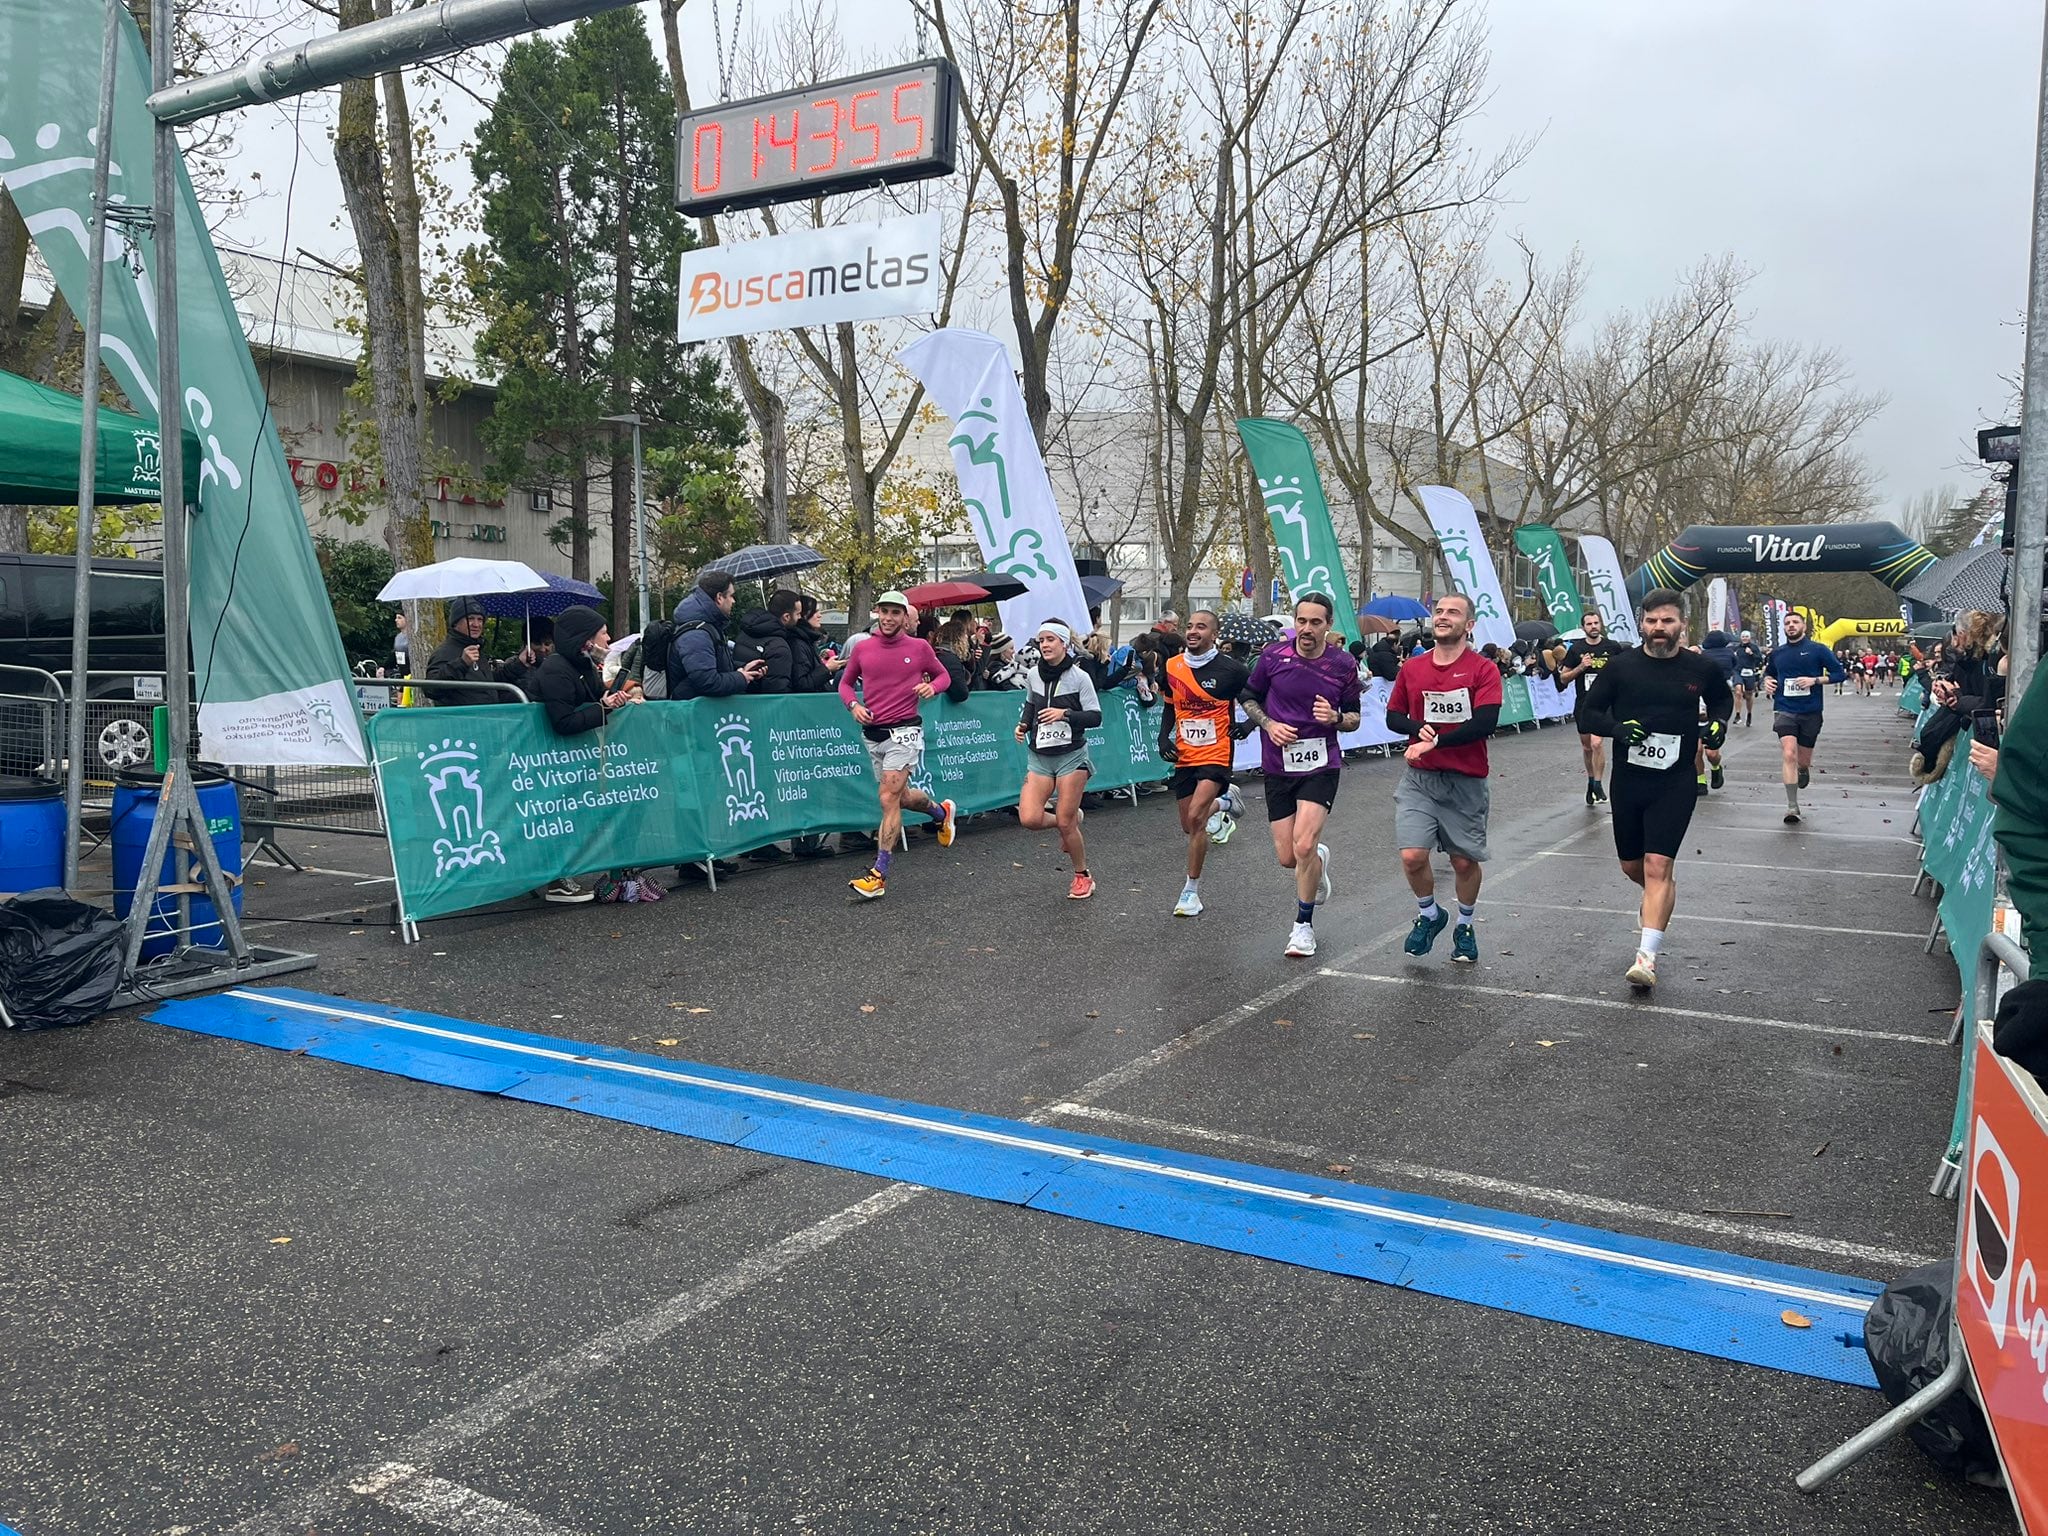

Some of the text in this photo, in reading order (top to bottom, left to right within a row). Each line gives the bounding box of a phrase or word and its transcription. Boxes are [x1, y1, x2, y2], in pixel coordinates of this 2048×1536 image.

[688, 246, 929, 319] Buscametas
[1747, 533, 1825, 562] Vital
[1873, 622, 1900, 633] BM
[1431, 702, 1463, 713] 2883
[934, 718, 982, 735] Ayuntamiento
[1186, 729, 1207, 738] 1719
[769, 725, 842, 746] Ayuntamiento
[936, 730, 997, 748] de Vitoria-Gasteiz
[1040, 731, 1066, 740] 2506
[508, 742, 628, 773] Ayuntamiento
[771, 741, 861, 761] de Vitoria-Gasteiz
[937, 749, 999, 766] Vitoria-Gasteizko
[1290, 750, 1319, 763] 1248
[1638, 744, 1666, 759] 280
[512, 758, 659, 792] de Vitoria-Gasteiz
[774, 762, 862, 783] Vitoria-Gasteizko
[941, 767, 964, 782] Udala
[515, 784, 659, 818] Vitoria-Gasteizko
[777, 785, 808, 802] Udala
[523, 817, 574, 840] Udala
